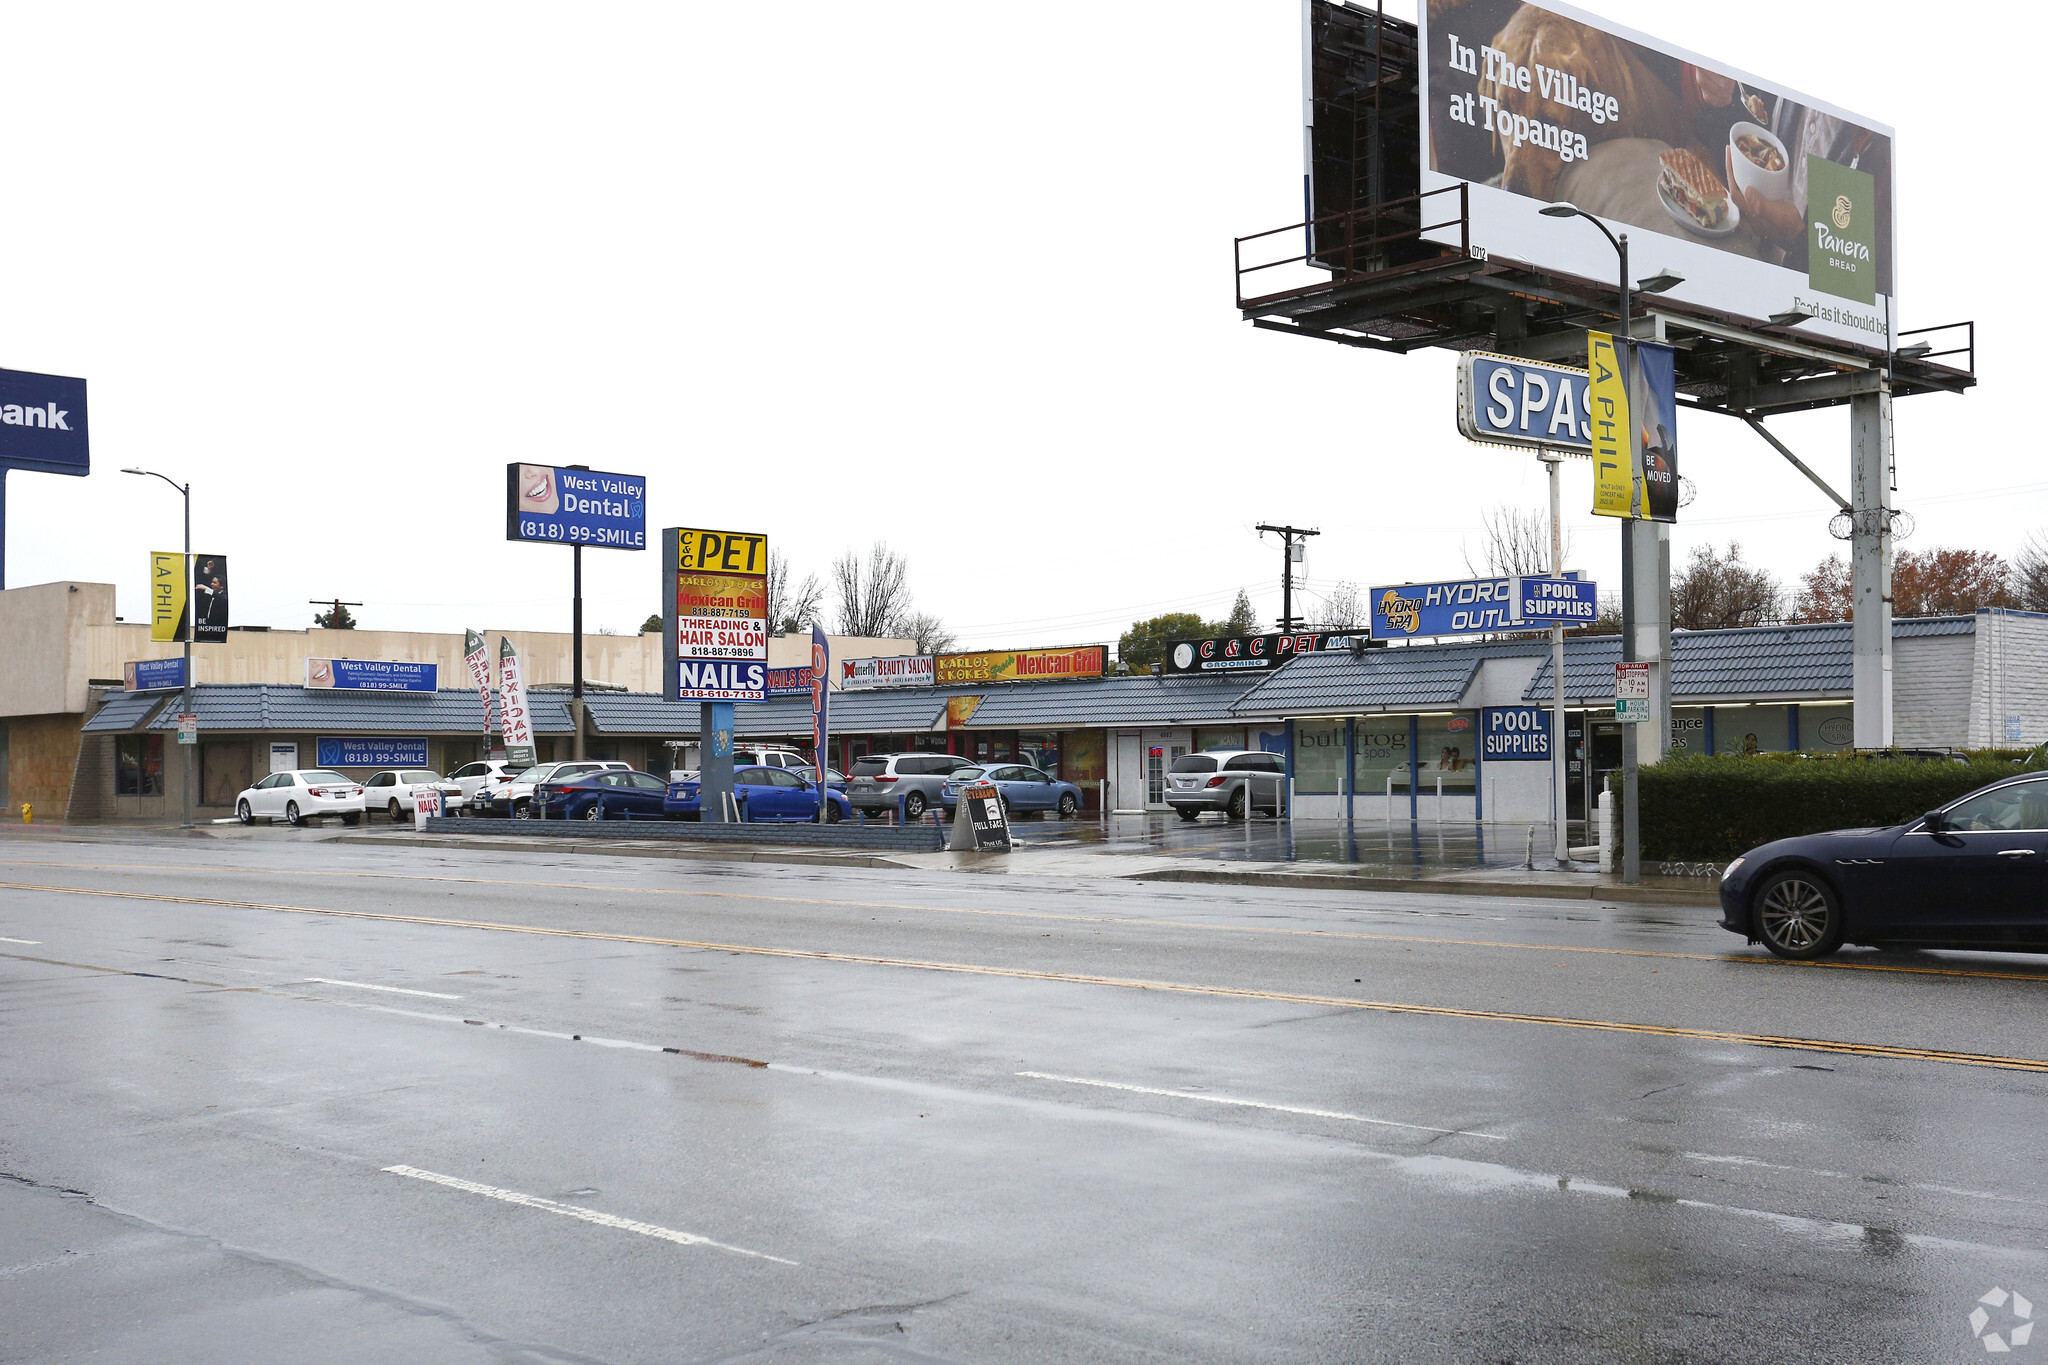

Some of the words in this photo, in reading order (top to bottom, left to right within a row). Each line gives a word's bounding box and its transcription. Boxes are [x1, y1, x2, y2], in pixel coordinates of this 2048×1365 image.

[1448, 33, 1477, 76] In
[1481, 45, 1531, 93] The
[1535, 63, 1619, 124] Village
[1450, 92, 1476, 126] at
[1480, 95, 1589, 163] Topanga
[1814, 222, 1870, 262] Panera
[1472, 244, 1486, 260] 0712
[1829, 257, 1857, 272] BREAD
[1821, 306, 1833, 322] as
[1834, 307, 1841, 324] it
[1841, 310, 1875, 332] should
[1595, 341, 1613, 383] LA
[1597, 397, 1618, 479] PHIL
[1646, 455, 1655, 466] BE
[1647, 470, 1671, 483] MOVED
[563, 475, 598, 491] West
[601, 479, 643, 499] Valley
[564, 493, 630, 518] Dental
[520, 520, 565, 540] (818)
[569, 526, 644, 546] 99-SMILE
[697, 533, 762, 571] PET
[156, 557, 171, 578] LA
[680, 577, 719, 587] KARLOS
[1425, 581, 1509, 606] HYDRO
[1541, 583, 1579, 599] POOL
[157, 584, 172, 625] PHIL
[678, 593, 734, 607] Mexican
[737, 595, 765, 608] Grill
[1377, 598, 1423, 615] HYDRO
[1525, 599, 1593, 617] SUPPLIES
[692, 607, 750, 618] 818-887-7159
[1451, 608, 1535, 630] OUTL
[682, 618, 749, 631] THREADING
[753, 622, 761, 631] &
[1385, 614, 1413, 630] SPA
[680, 631, 714, 646] HAIR
[718, 632, 764, 647] SALON
[1200, 640, 1215, 659] C
[1225, 639, 1240, 658] &
[1250, 637, 1265, 656] C
[1276, 634, 1321, 655] PET
[1326, 635, 1369, 650] MAT
[691, 647, 754, 657] 818-887-9896
[150, 661, 163, 671] Valley
[164, 659, 179, 669] Dental
[340, 661, 363, 671] West
[364, 662, 391, 674] Valley
[393, 663, 422, 673] Dental
[878, 659, 906, 676] BEAUTY
[908, 658, 932, 674] SALON
[939, 656, 989, 669] KARLOS
[1016, 653, 1071, 675] Mexican
[1073, 650, 1101, 673] Grill
[1206, 660, 1263, 668] GROOMING
[680, 662, 765, 690] NAILS
[767, 669, 796, 689] NAILS
[799, 668, 813, 686] SP
[937, 672, 946, 681] &
[947, 668, 991, 681] KOKES
[1617, 670, 1625, 678] NO
[378, 682, 408, 690] 99-SMILE
[682, 689, 762, 699] 818-610-7133
[1448, 720, 1469, 730] OPEN
[1491, 711, 1543, 732] POOL
[1824, 724, 1854, 732] HYDRO
[343, 742, 366, 750] West
[368, 742, 395, 752] Valley
[397, 742, 425, 750] Dental
[1486, 733, 1548, 753] SUPPLIES
[344, 753, 373, 763] (818)
[376, 753, 424, 763] 99-SMILE
[1364, 749, 1391, 761] spas
[418, 799, 439, 813] NAILS
[973, 821, 988, 831] FULL
[989, 820, 1004, 829] FACE
